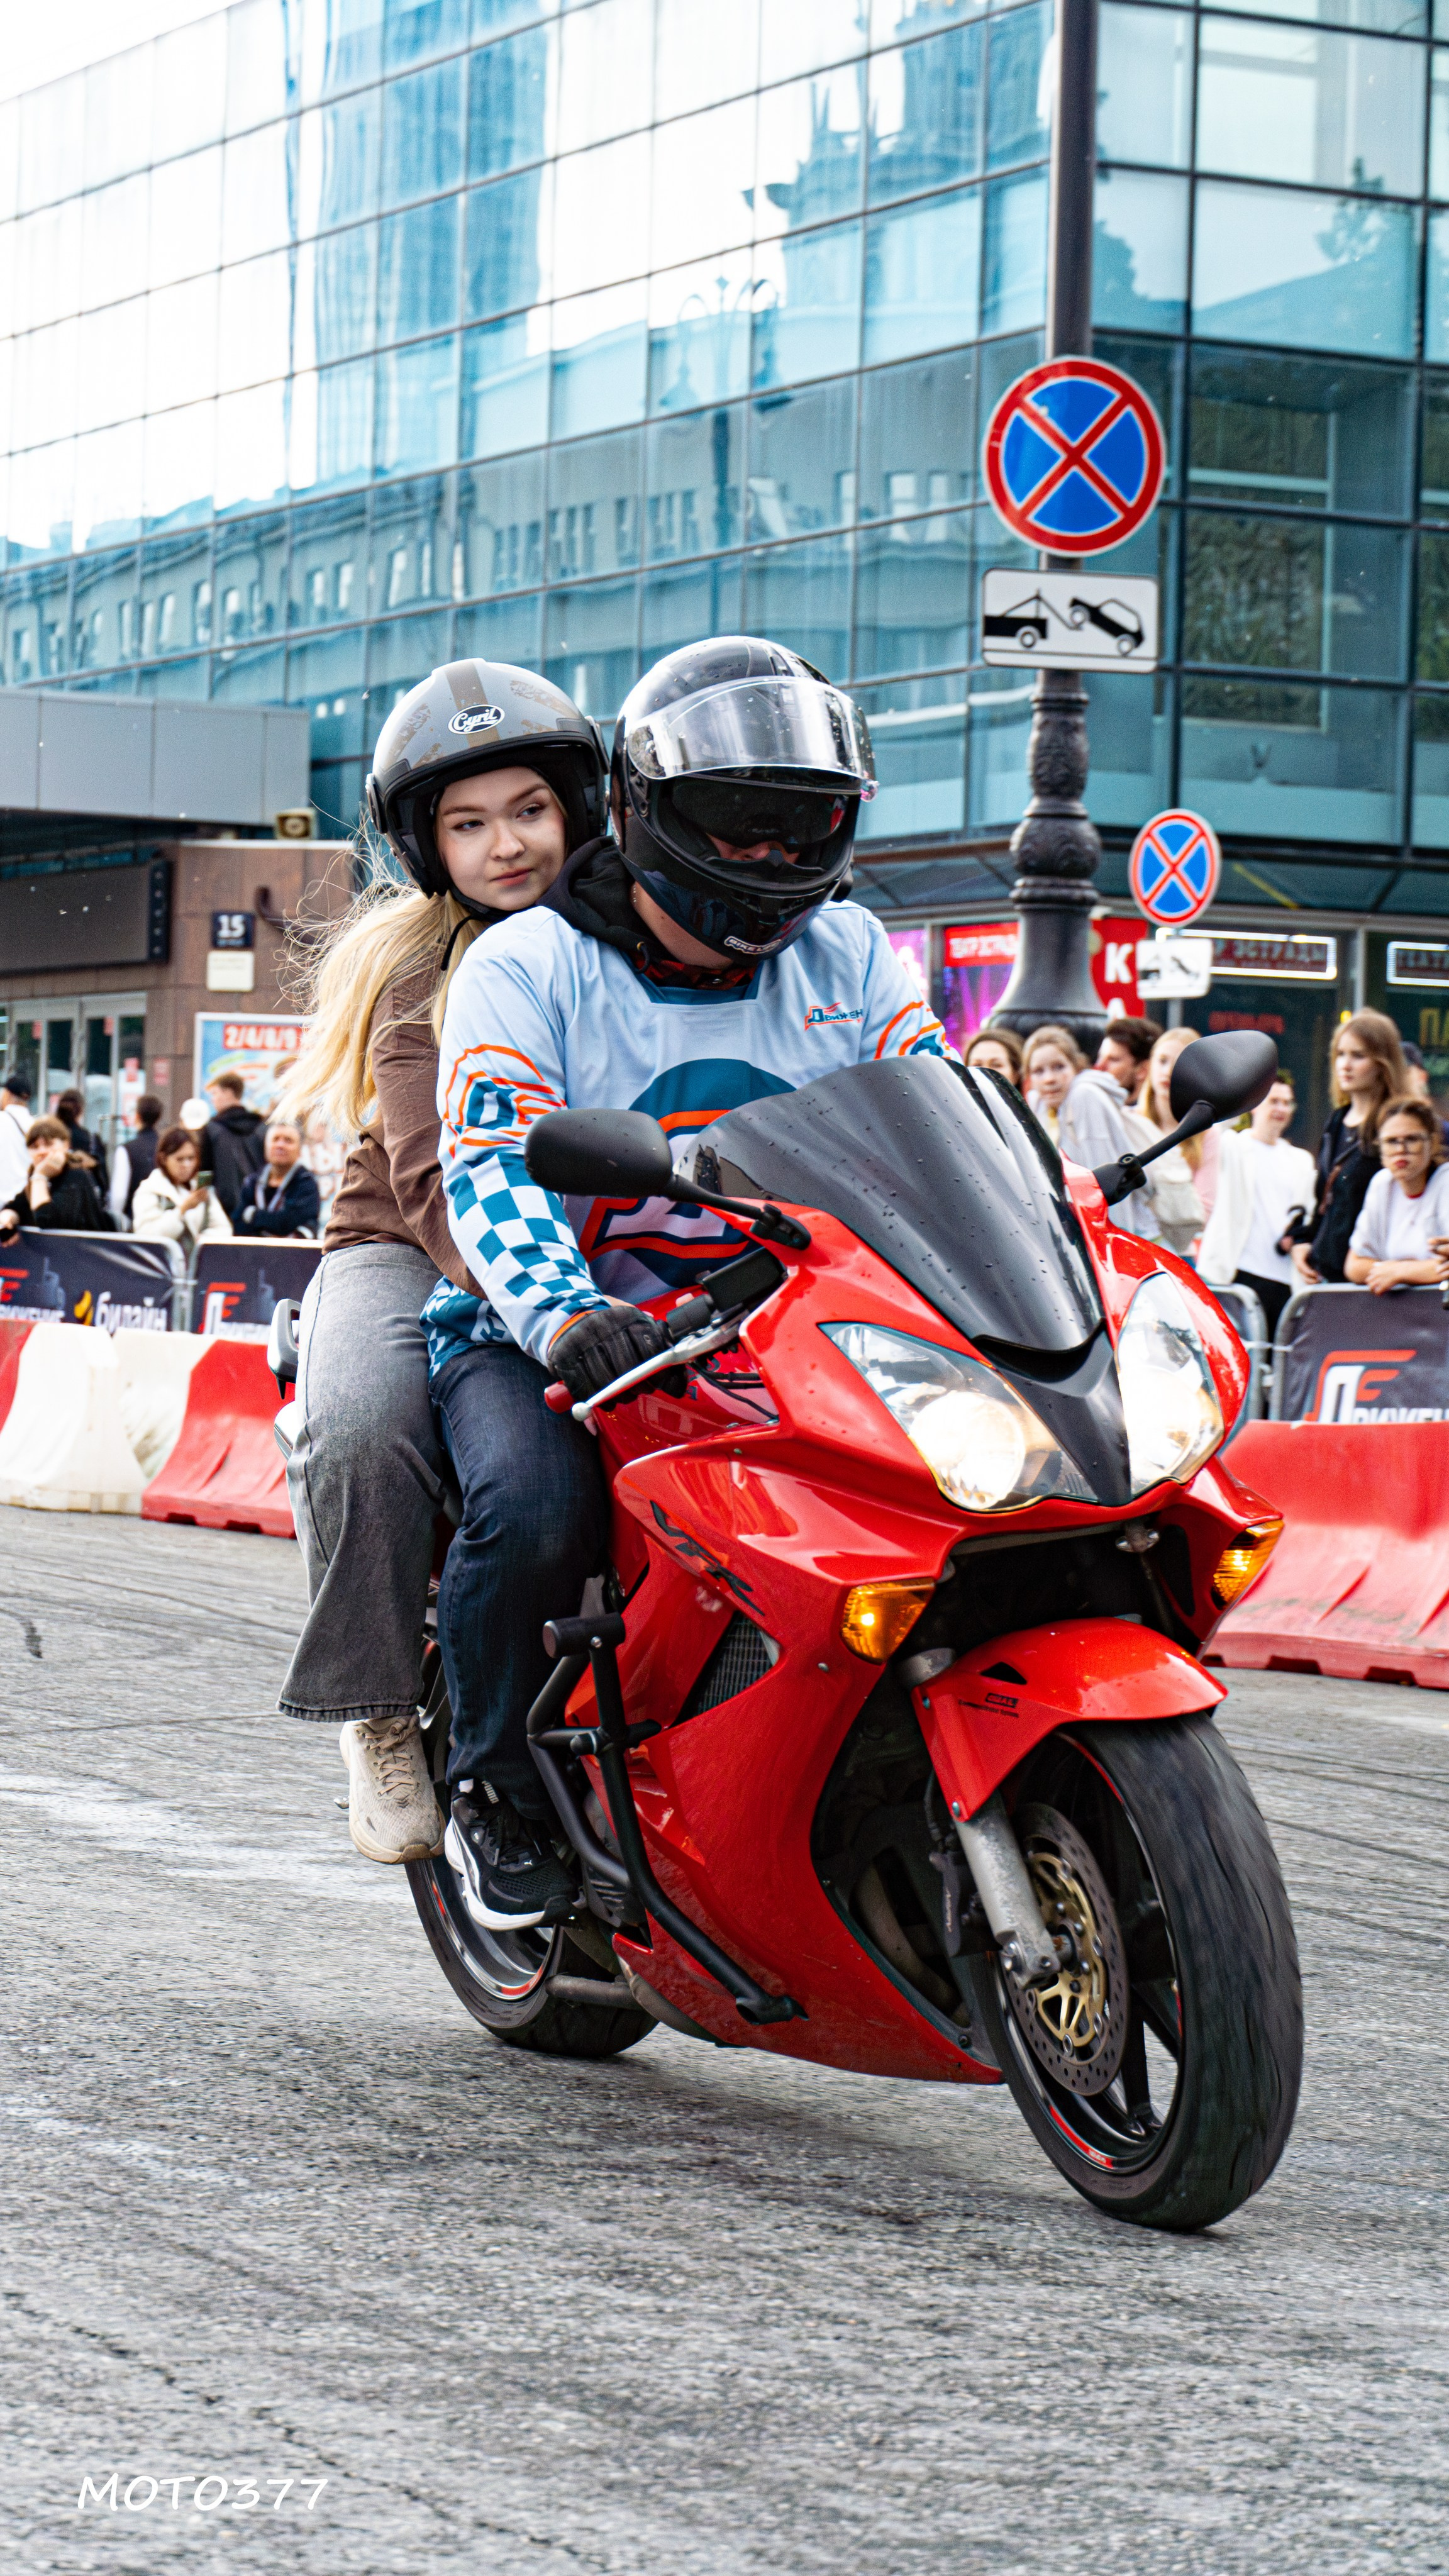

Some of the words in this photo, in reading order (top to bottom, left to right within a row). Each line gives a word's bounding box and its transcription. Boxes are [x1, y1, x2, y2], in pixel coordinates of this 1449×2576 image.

[453, 708, 499, 733] Cyril
[217, 914, 245, 938] 15
[95, 1291, 167, 1333] билайн
